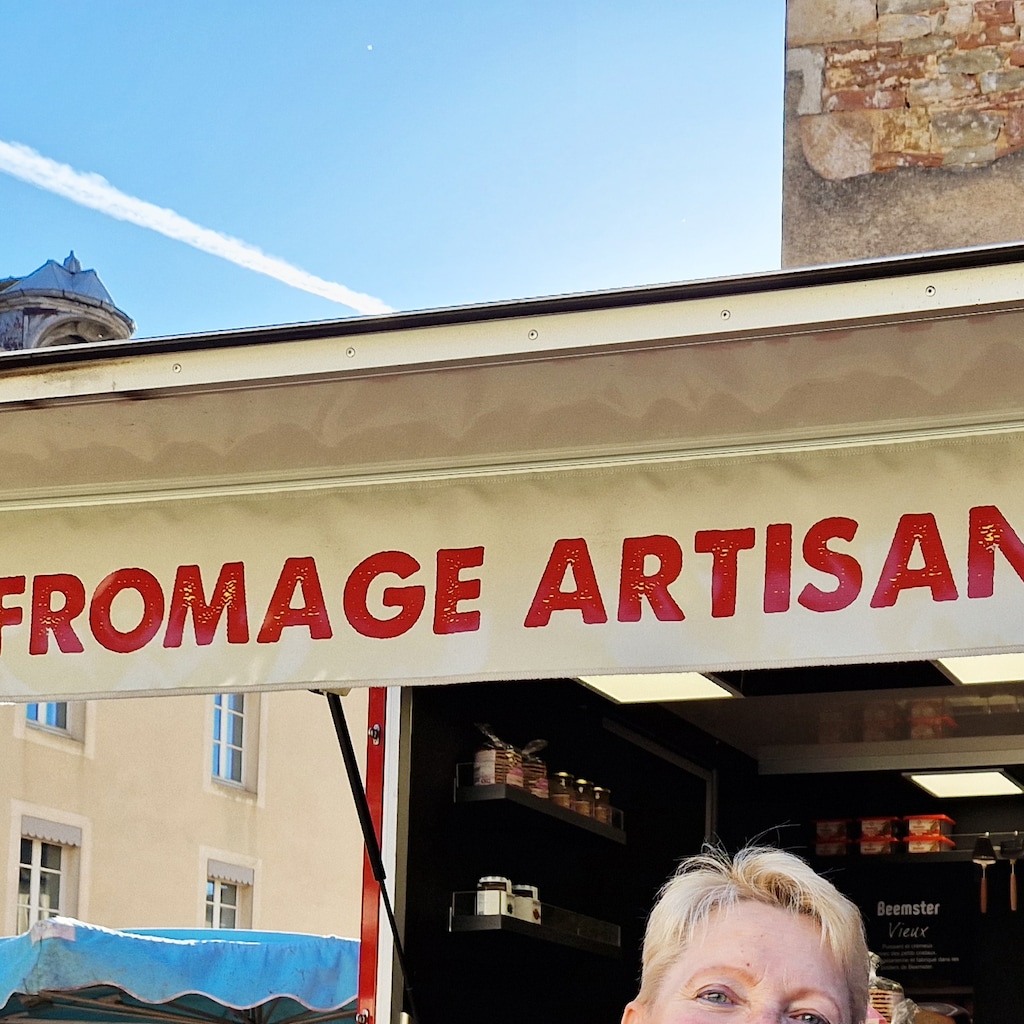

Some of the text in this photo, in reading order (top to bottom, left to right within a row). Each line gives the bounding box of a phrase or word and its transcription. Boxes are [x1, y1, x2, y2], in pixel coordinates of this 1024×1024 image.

[0, 546, 486, 656] FROMAGE
[877, 901, 940, 916] Beemster
[888, 921, 930, 939] Vieux
